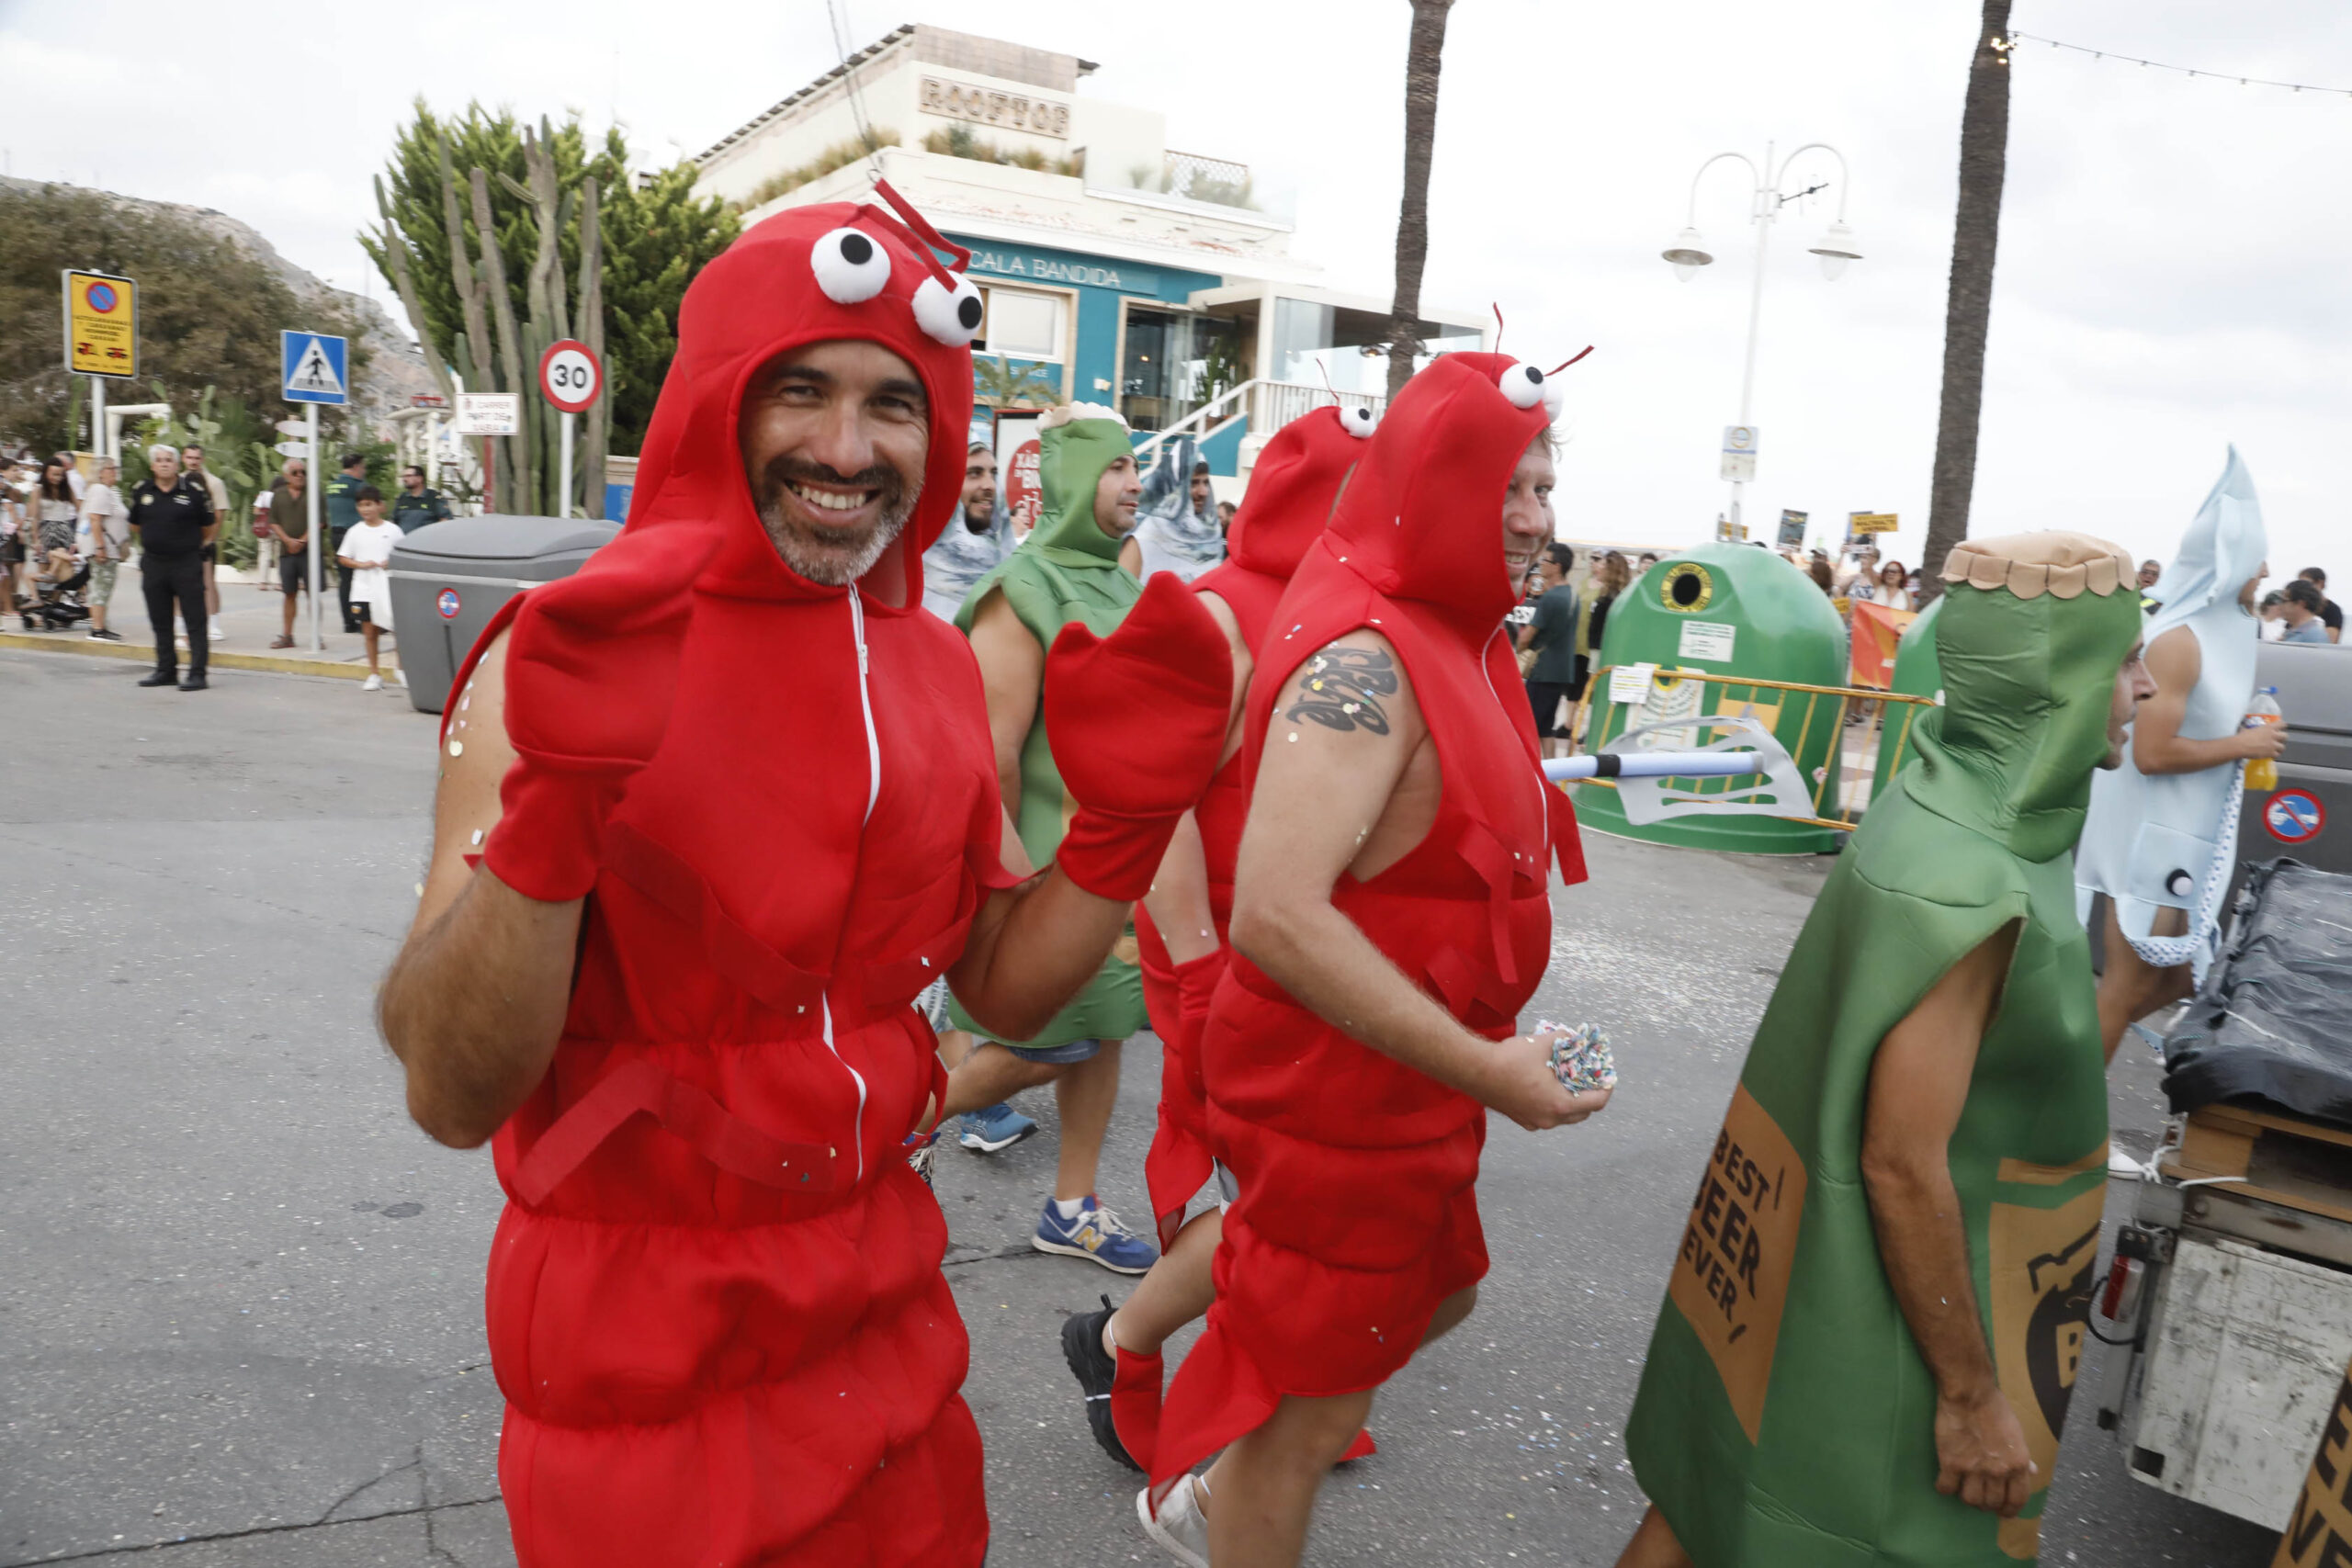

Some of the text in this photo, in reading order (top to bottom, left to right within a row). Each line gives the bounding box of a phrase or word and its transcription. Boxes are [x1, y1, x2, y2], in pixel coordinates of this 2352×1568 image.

[920, 78, 1069, 134] ROOFTOP
[969, 250, 1122, 288] CALA BANDIDA
[554, 364, 586, 389] 30
[1714, 1126, 1770, 1213] BEST
[1694, 1162, 1757, 1301] EER
[1682, 1223, 1737, 1323] EVER
